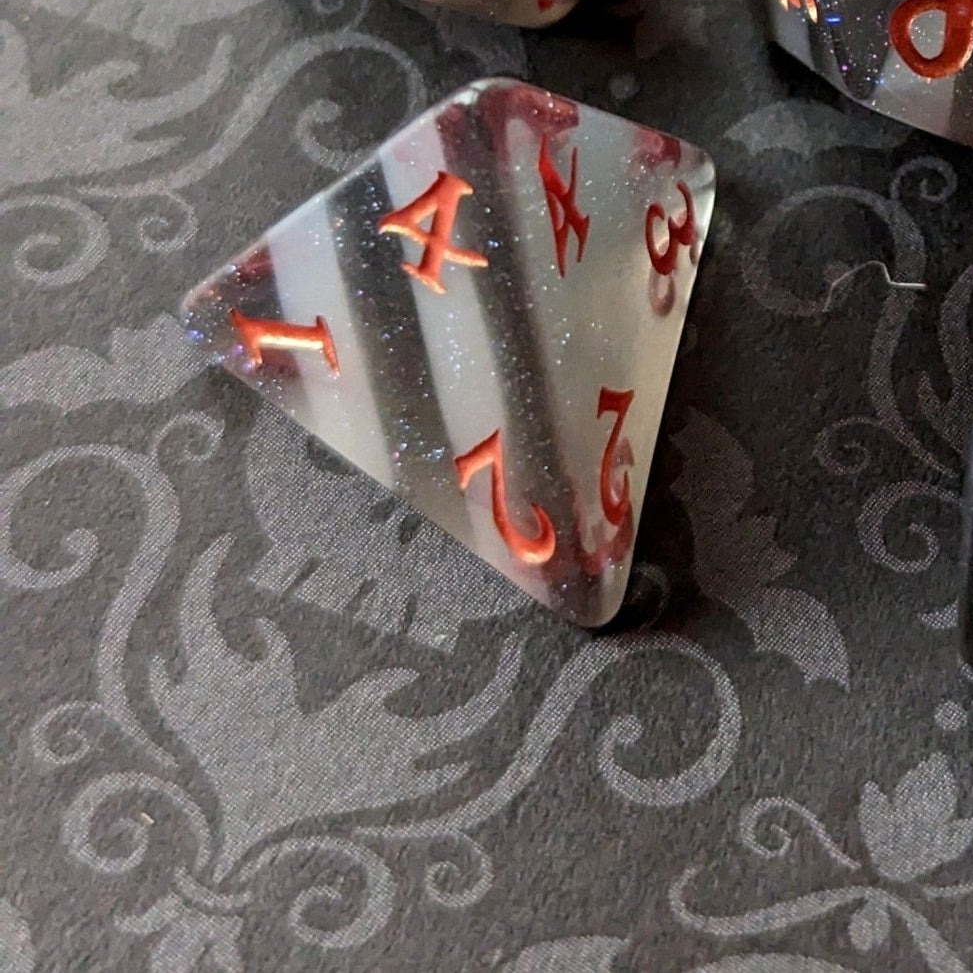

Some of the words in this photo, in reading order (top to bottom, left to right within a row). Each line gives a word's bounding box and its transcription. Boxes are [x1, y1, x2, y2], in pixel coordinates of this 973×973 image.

[378, 170, 488, 293] 4
[538, 132, 592, 279] 4
[645, 180, 696, 276] 3
[229, 307, 341, 377] 1
[454, 428, 558, 566] 2
[597, 386, 636, 528] 2
